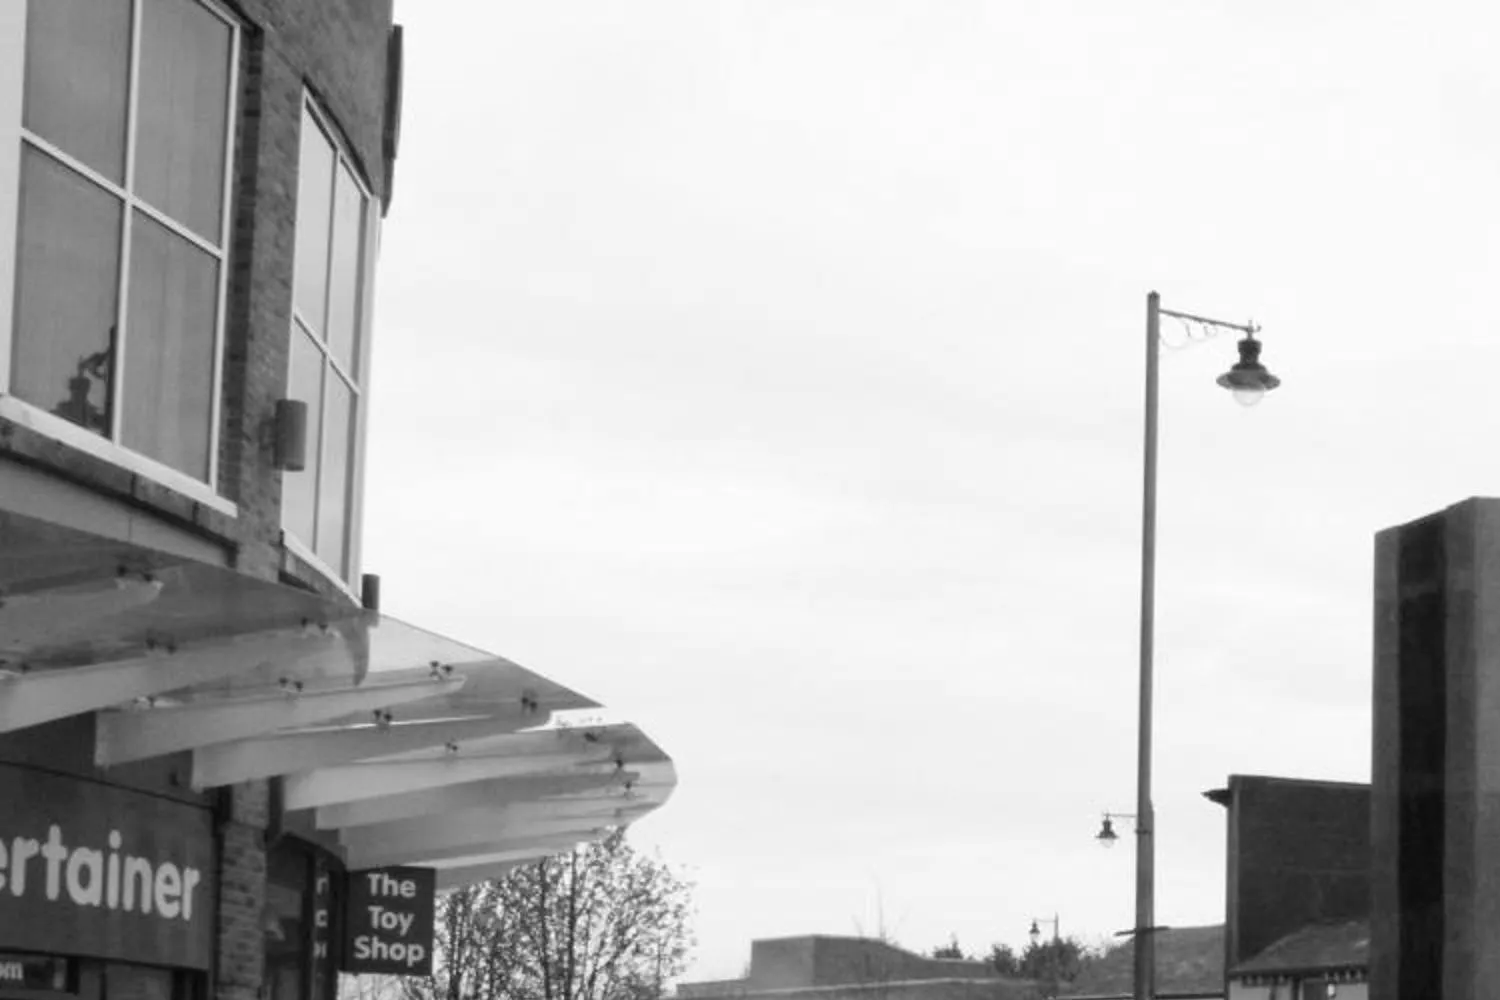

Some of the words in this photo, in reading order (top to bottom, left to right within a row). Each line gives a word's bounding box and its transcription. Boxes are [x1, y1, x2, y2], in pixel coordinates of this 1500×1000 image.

[366, 871, 417, 898] The
[367, 904, 415, 936] Toy
[353, 935, 425, 967] Shop
